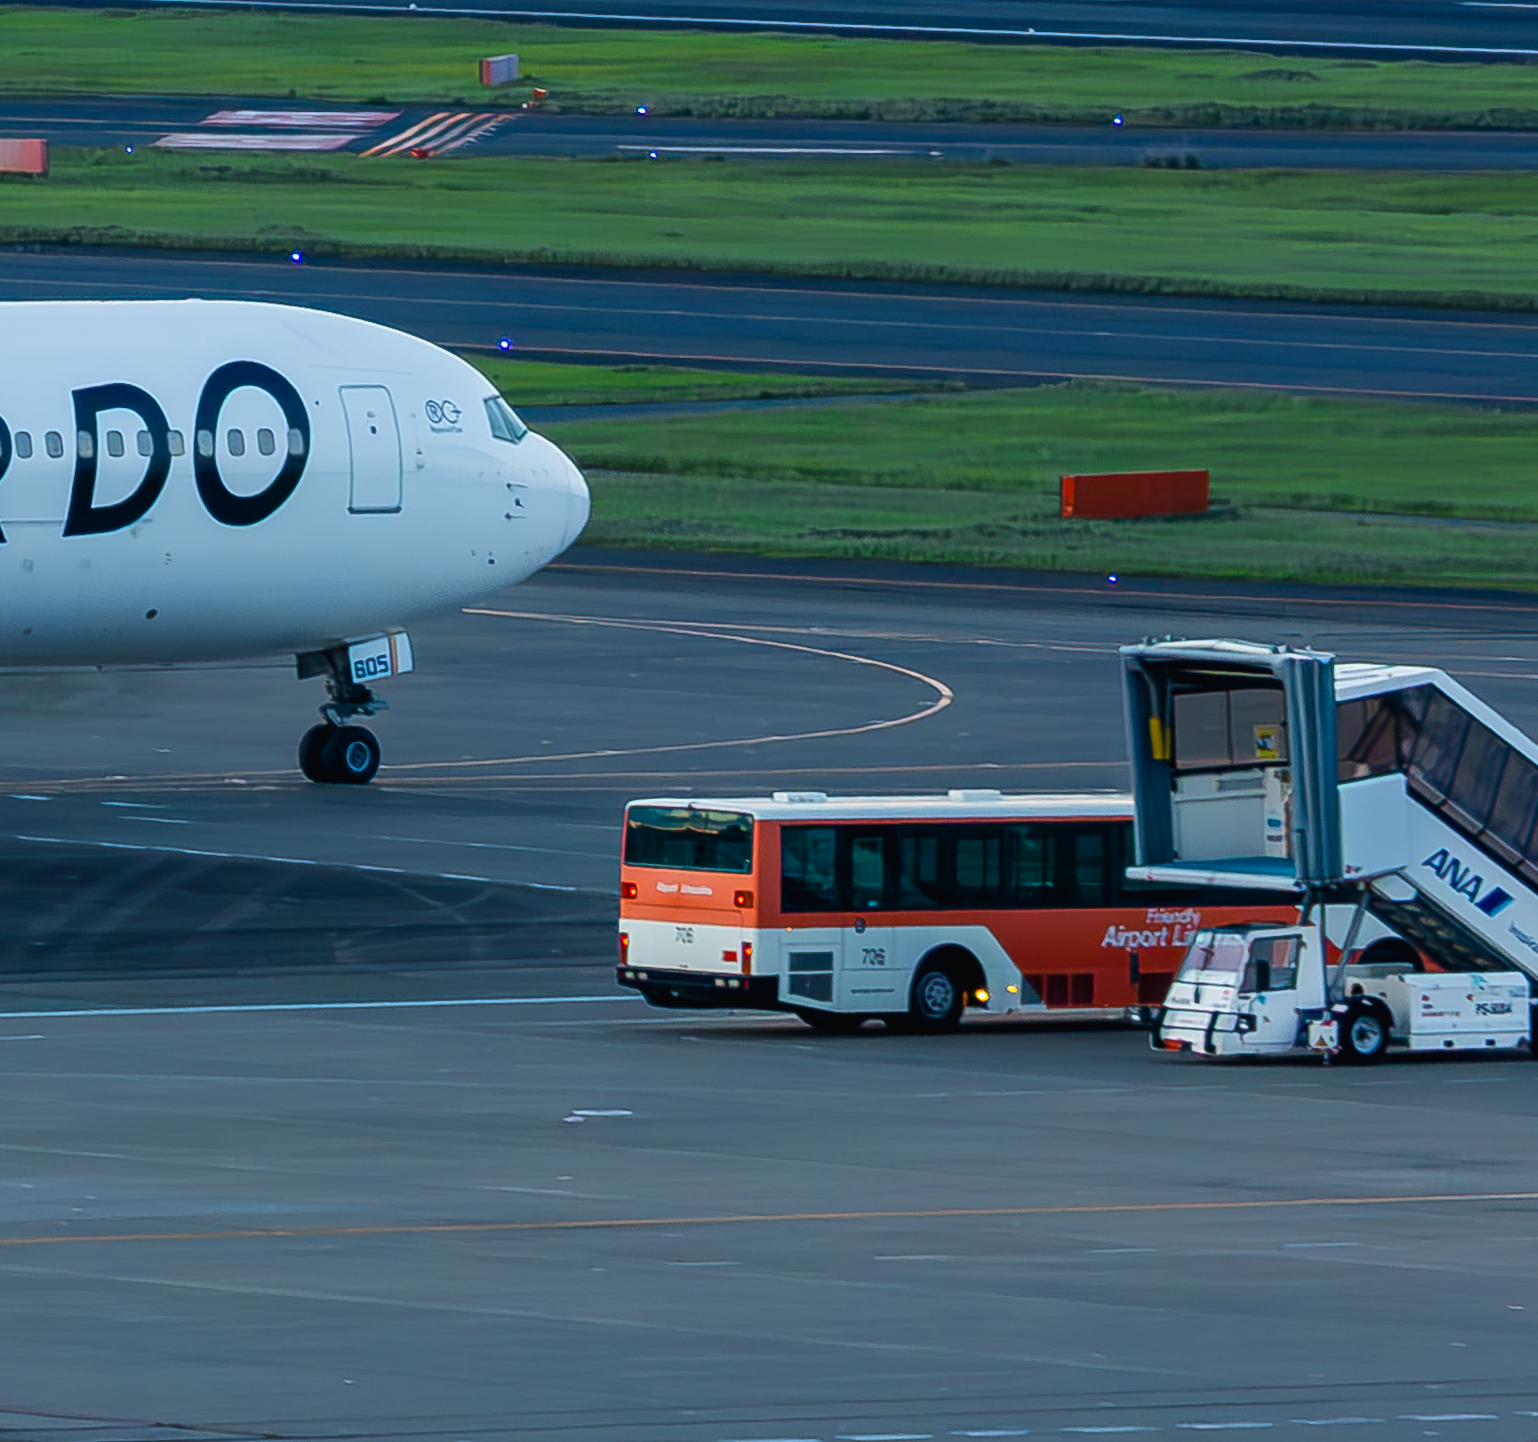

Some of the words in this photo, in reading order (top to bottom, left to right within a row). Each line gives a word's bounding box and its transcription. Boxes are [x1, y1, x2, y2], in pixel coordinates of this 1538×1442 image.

[61, 360, 311, 537] DO
[354, 654, 389, 678] 605
[1421, 848, 1484, 903] ANA
[1101, 924, 1168, 951] Airport
